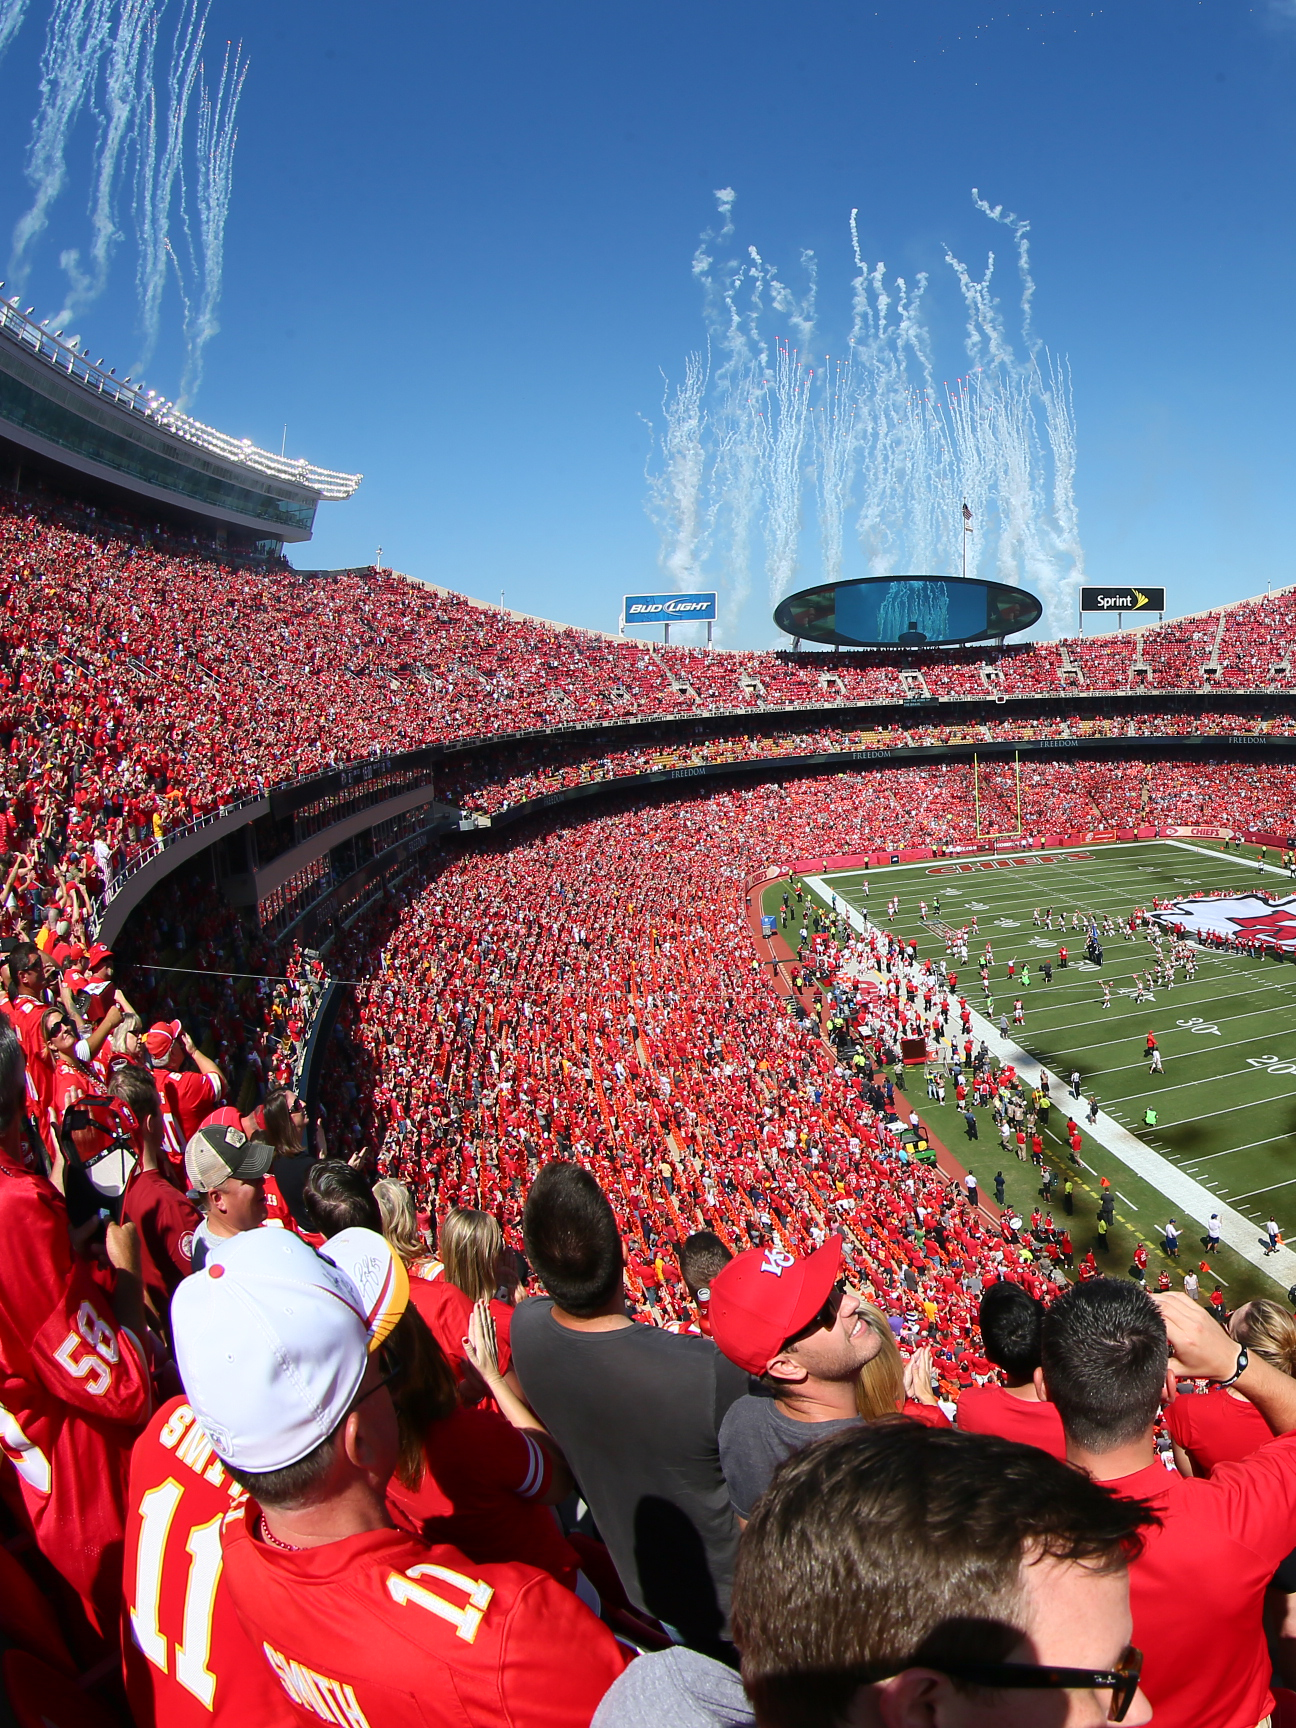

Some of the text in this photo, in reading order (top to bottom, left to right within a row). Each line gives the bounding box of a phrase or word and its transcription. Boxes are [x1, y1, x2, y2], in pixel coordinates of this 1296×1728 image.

[629, 602, 712, 614] BUD LIGHT
[1097, 594, 1132, 610] Sprint
[853, 751, 891, 760] FREEDOM
[671, 768, 706, 778] FREEDOM
[544, 794, 564, 806] FREEDOM
[1191, 828, 1220, 836] CHIEFS
[926, 852, 1096, 874] CHIEFS
[1176, 1018, 1221, 1035] 30
[760, 1248, 794, 1277] KC
[54, 1300, 120, 1396] 58
[130, 1476, 224, 1712] 11
[386, 1564, 495, 1644] 11
[263, 1641, 371, 1728] SMITH
